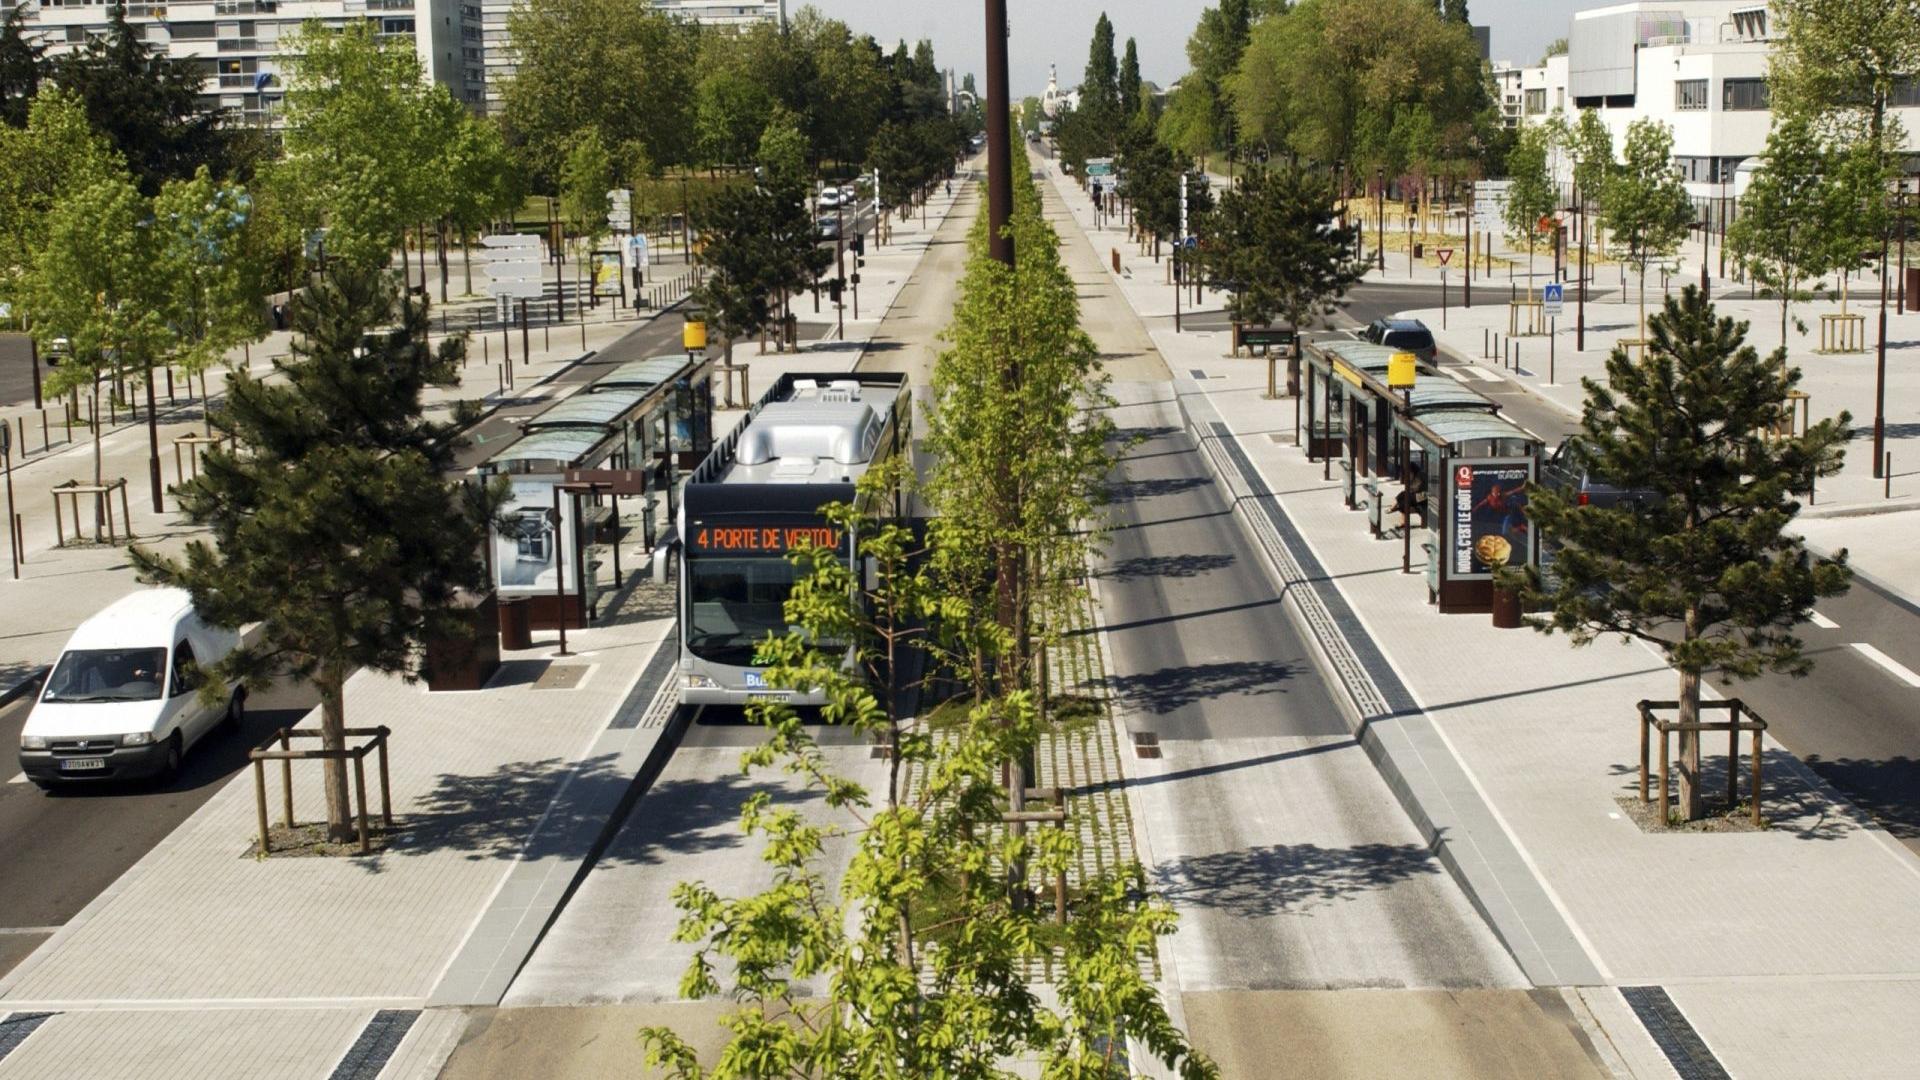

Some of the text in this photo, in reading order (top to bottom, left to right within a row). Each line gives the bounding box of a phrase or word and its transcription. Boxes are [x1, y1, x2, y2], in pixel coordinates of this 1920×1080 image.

[1458, 512, 1472, 522] LE
[697, 528, 709, 549] 4
[713, 528, 758, 549] PORTE
[762, 528, 780, 549] DE
